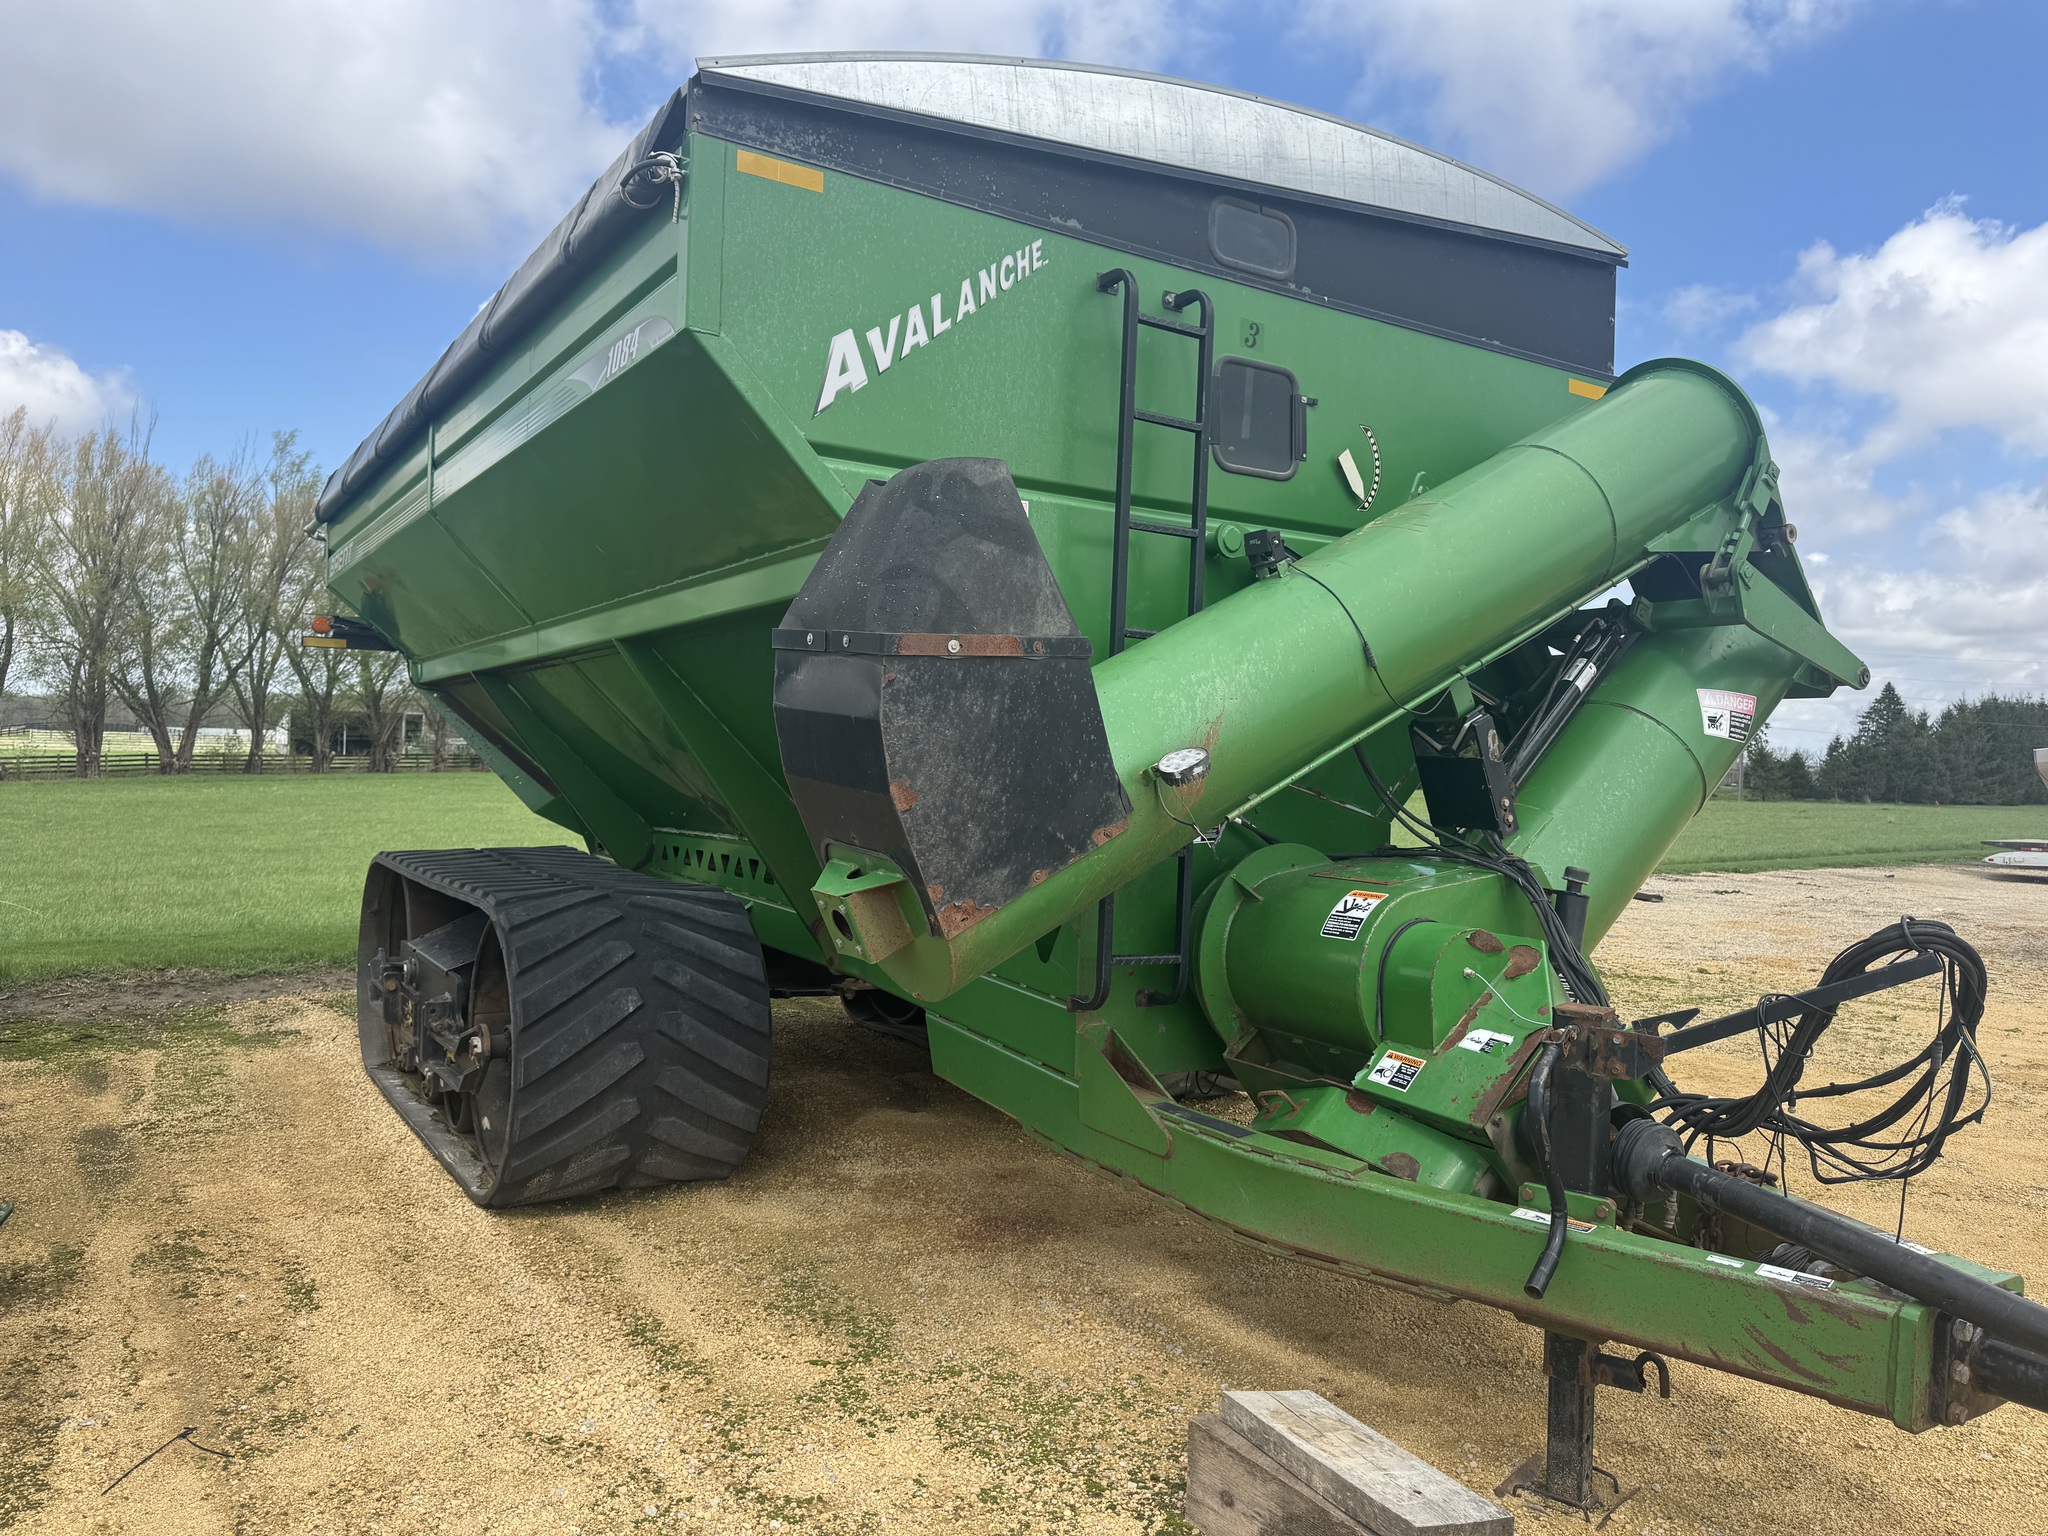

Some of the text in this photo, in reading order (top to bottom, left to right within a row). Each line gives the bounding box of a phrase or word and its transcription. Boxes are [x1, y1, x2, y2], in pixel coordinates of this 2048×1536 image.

[812, 237, 1043, 420] AVALANCHE
[1244, 322, 1260, 349] 3
[606, 326, 640, 378] 1084
[1716, 694, 1754, 712] DANGER
[1393, 1053, 1423, 1068] WARNING
